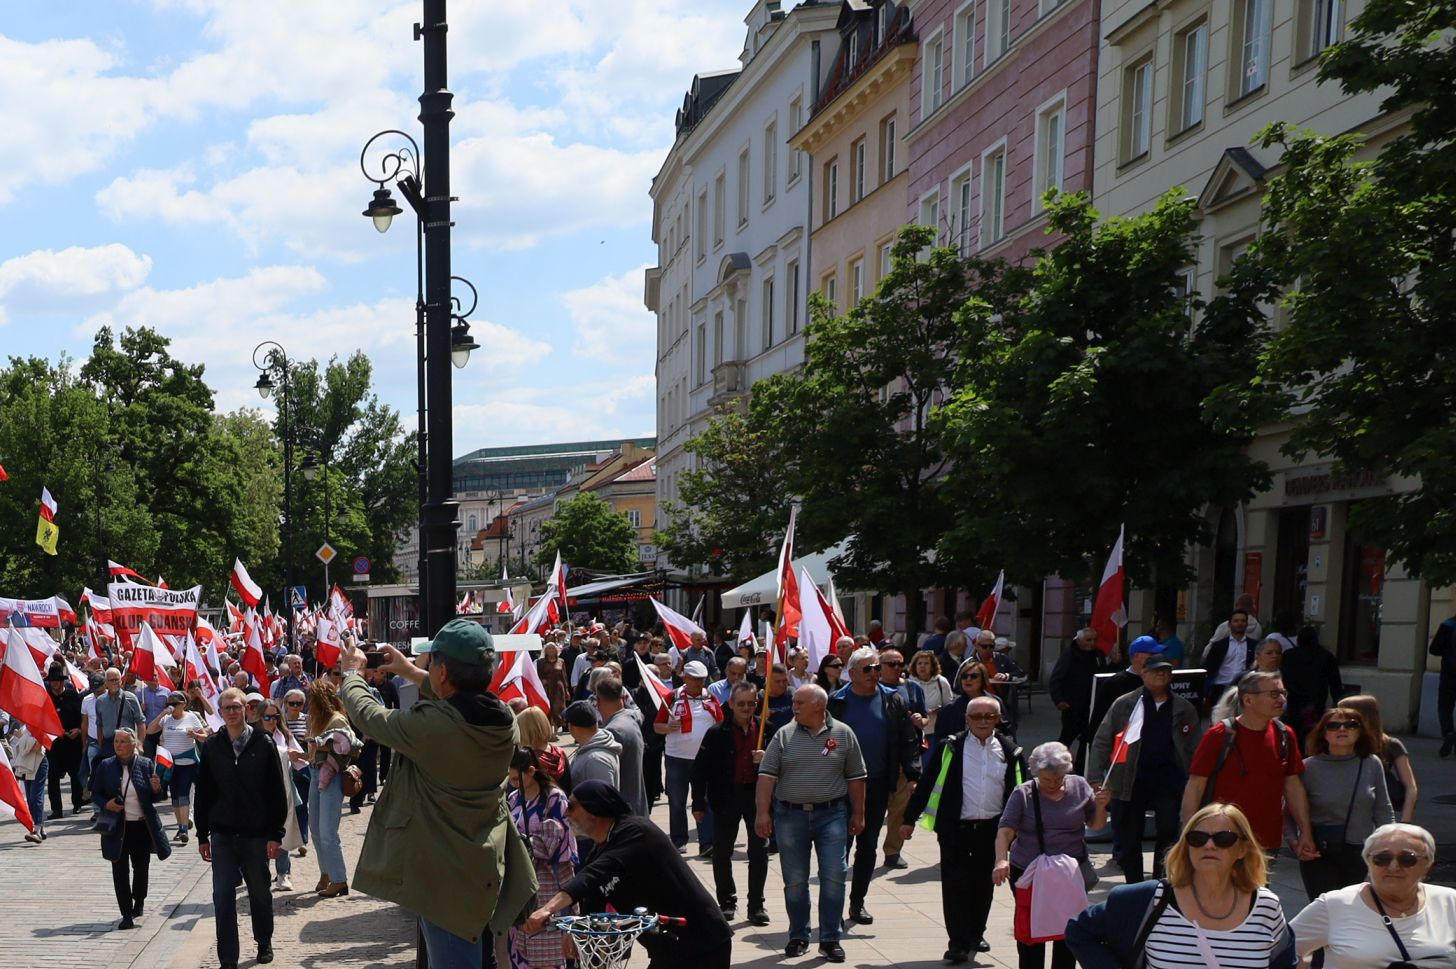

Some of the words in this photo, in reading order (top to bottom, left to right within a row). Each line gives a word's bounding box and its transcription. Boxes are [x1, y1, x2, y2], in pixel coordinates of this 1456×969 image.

[117, 588, 155, 601] GAZETA
[164, 591, 197, 603] POLSKA
[28, 603, 53, 613] NAWROCKI
[389, 620, 420, 629] COFFE
[390, 641, 411, 650] RESH
